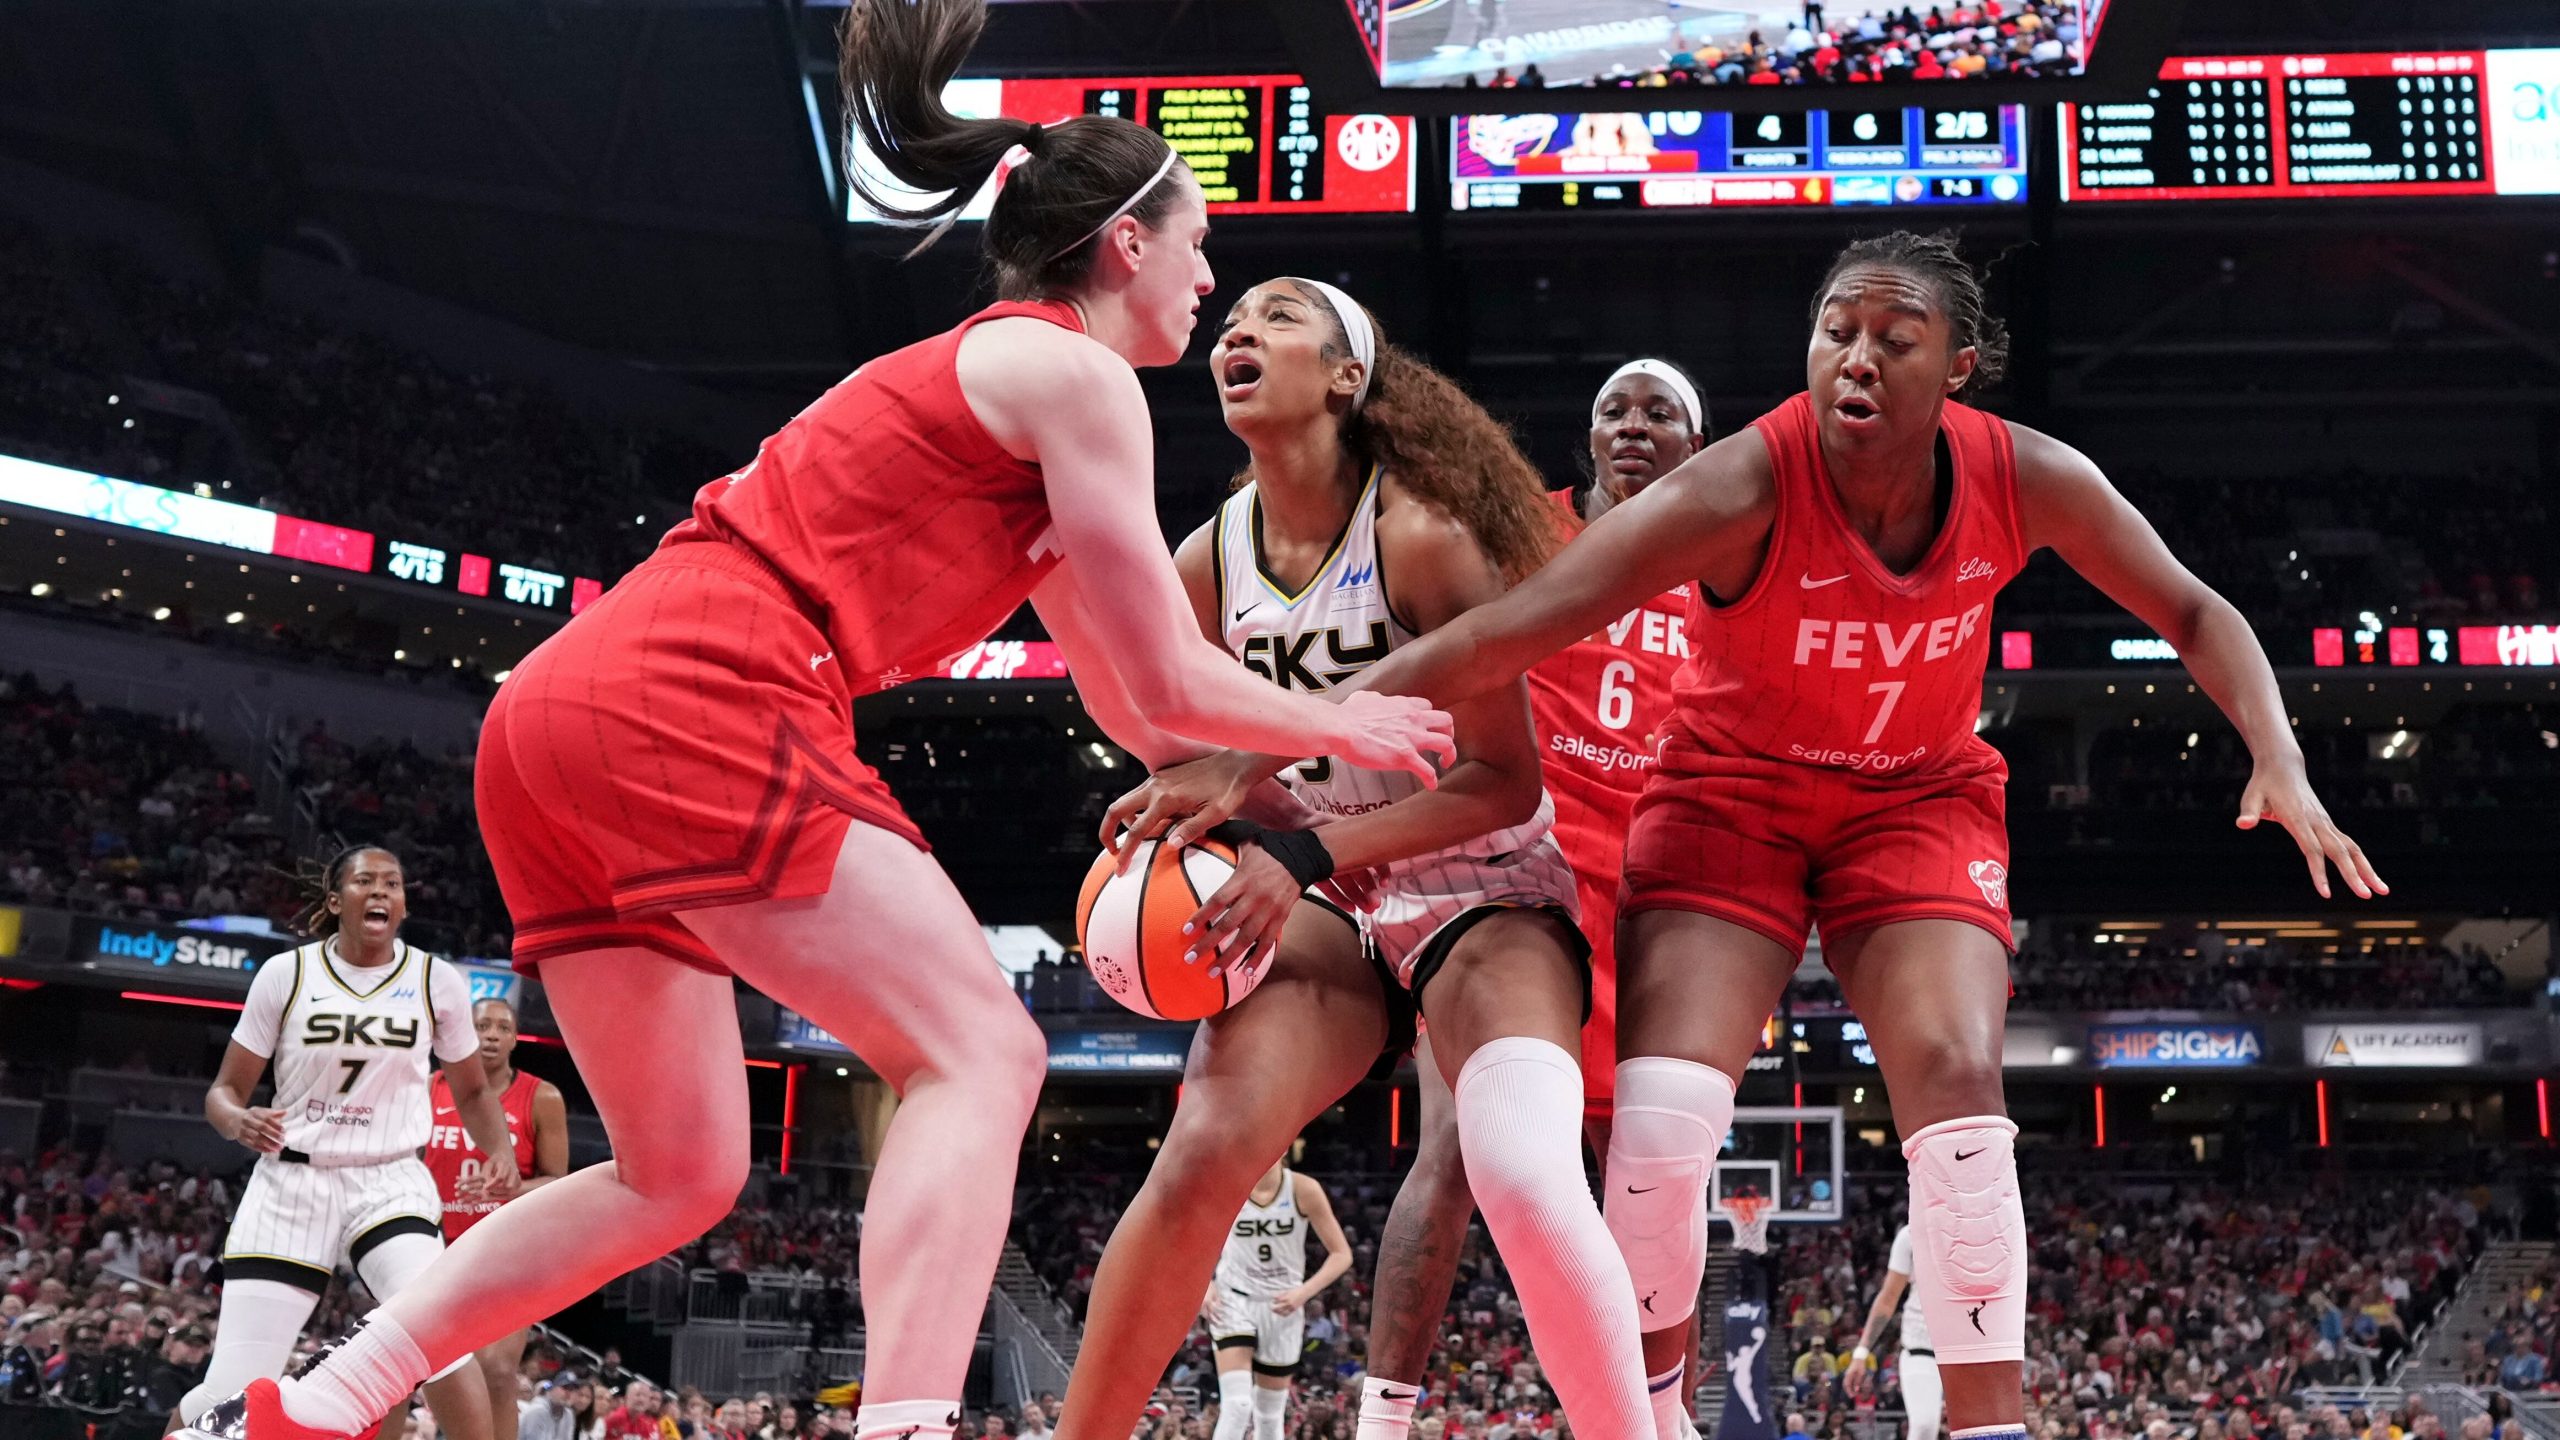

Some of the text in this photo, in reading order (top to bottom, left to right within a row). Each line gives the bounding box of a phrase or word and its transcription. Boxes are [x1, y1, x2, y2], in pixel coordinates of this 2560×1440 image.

[1757, 115, 1782, 141] 4
[1853, 113, 1878, 140] 6
[1957, 557, 1998, 583] Lilly
[1605, 607, 1691, 660] VER
[1793, 603, 1985, 669] FEVER
[1597, 660, 1636, 730] 6
[1862, 681, 1907, 745] 7
[302, 1013, 418, 1049] SKY
[2091, 1030, 2261, 1060] SHIPSIGMA
[338, 1059, 371, 1094] 7
[1234, 1218, 1295, 1238] SKY
[1257, 1243, 1272, 1263] 9
